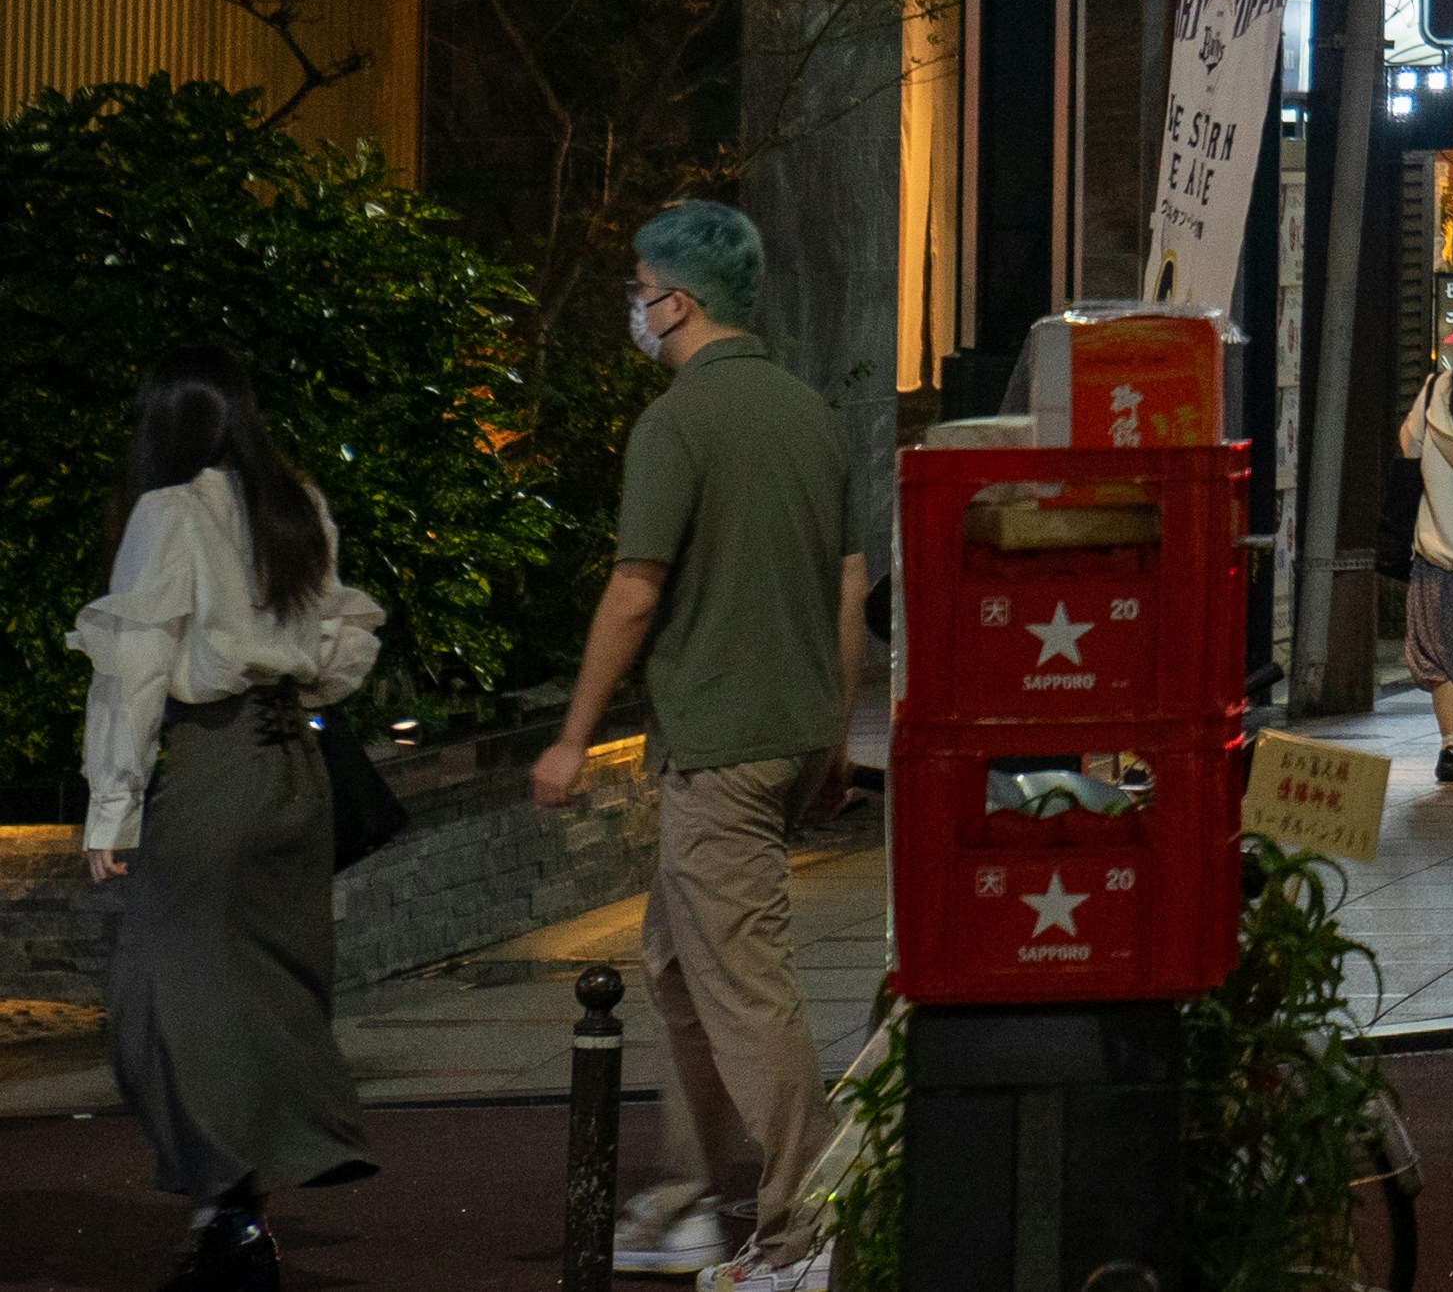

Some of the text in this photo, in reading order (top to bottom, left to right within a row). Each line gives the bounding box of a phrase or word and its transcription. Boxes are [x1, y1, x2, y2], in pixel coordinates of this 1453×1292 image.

[1109, 597, 1140, 621] 20
[1022, 672, 1096, 691] SAPPORO
[1105, 867, 1136, 891] 20
[1017, 944, 1092, 962] SAPPORO
